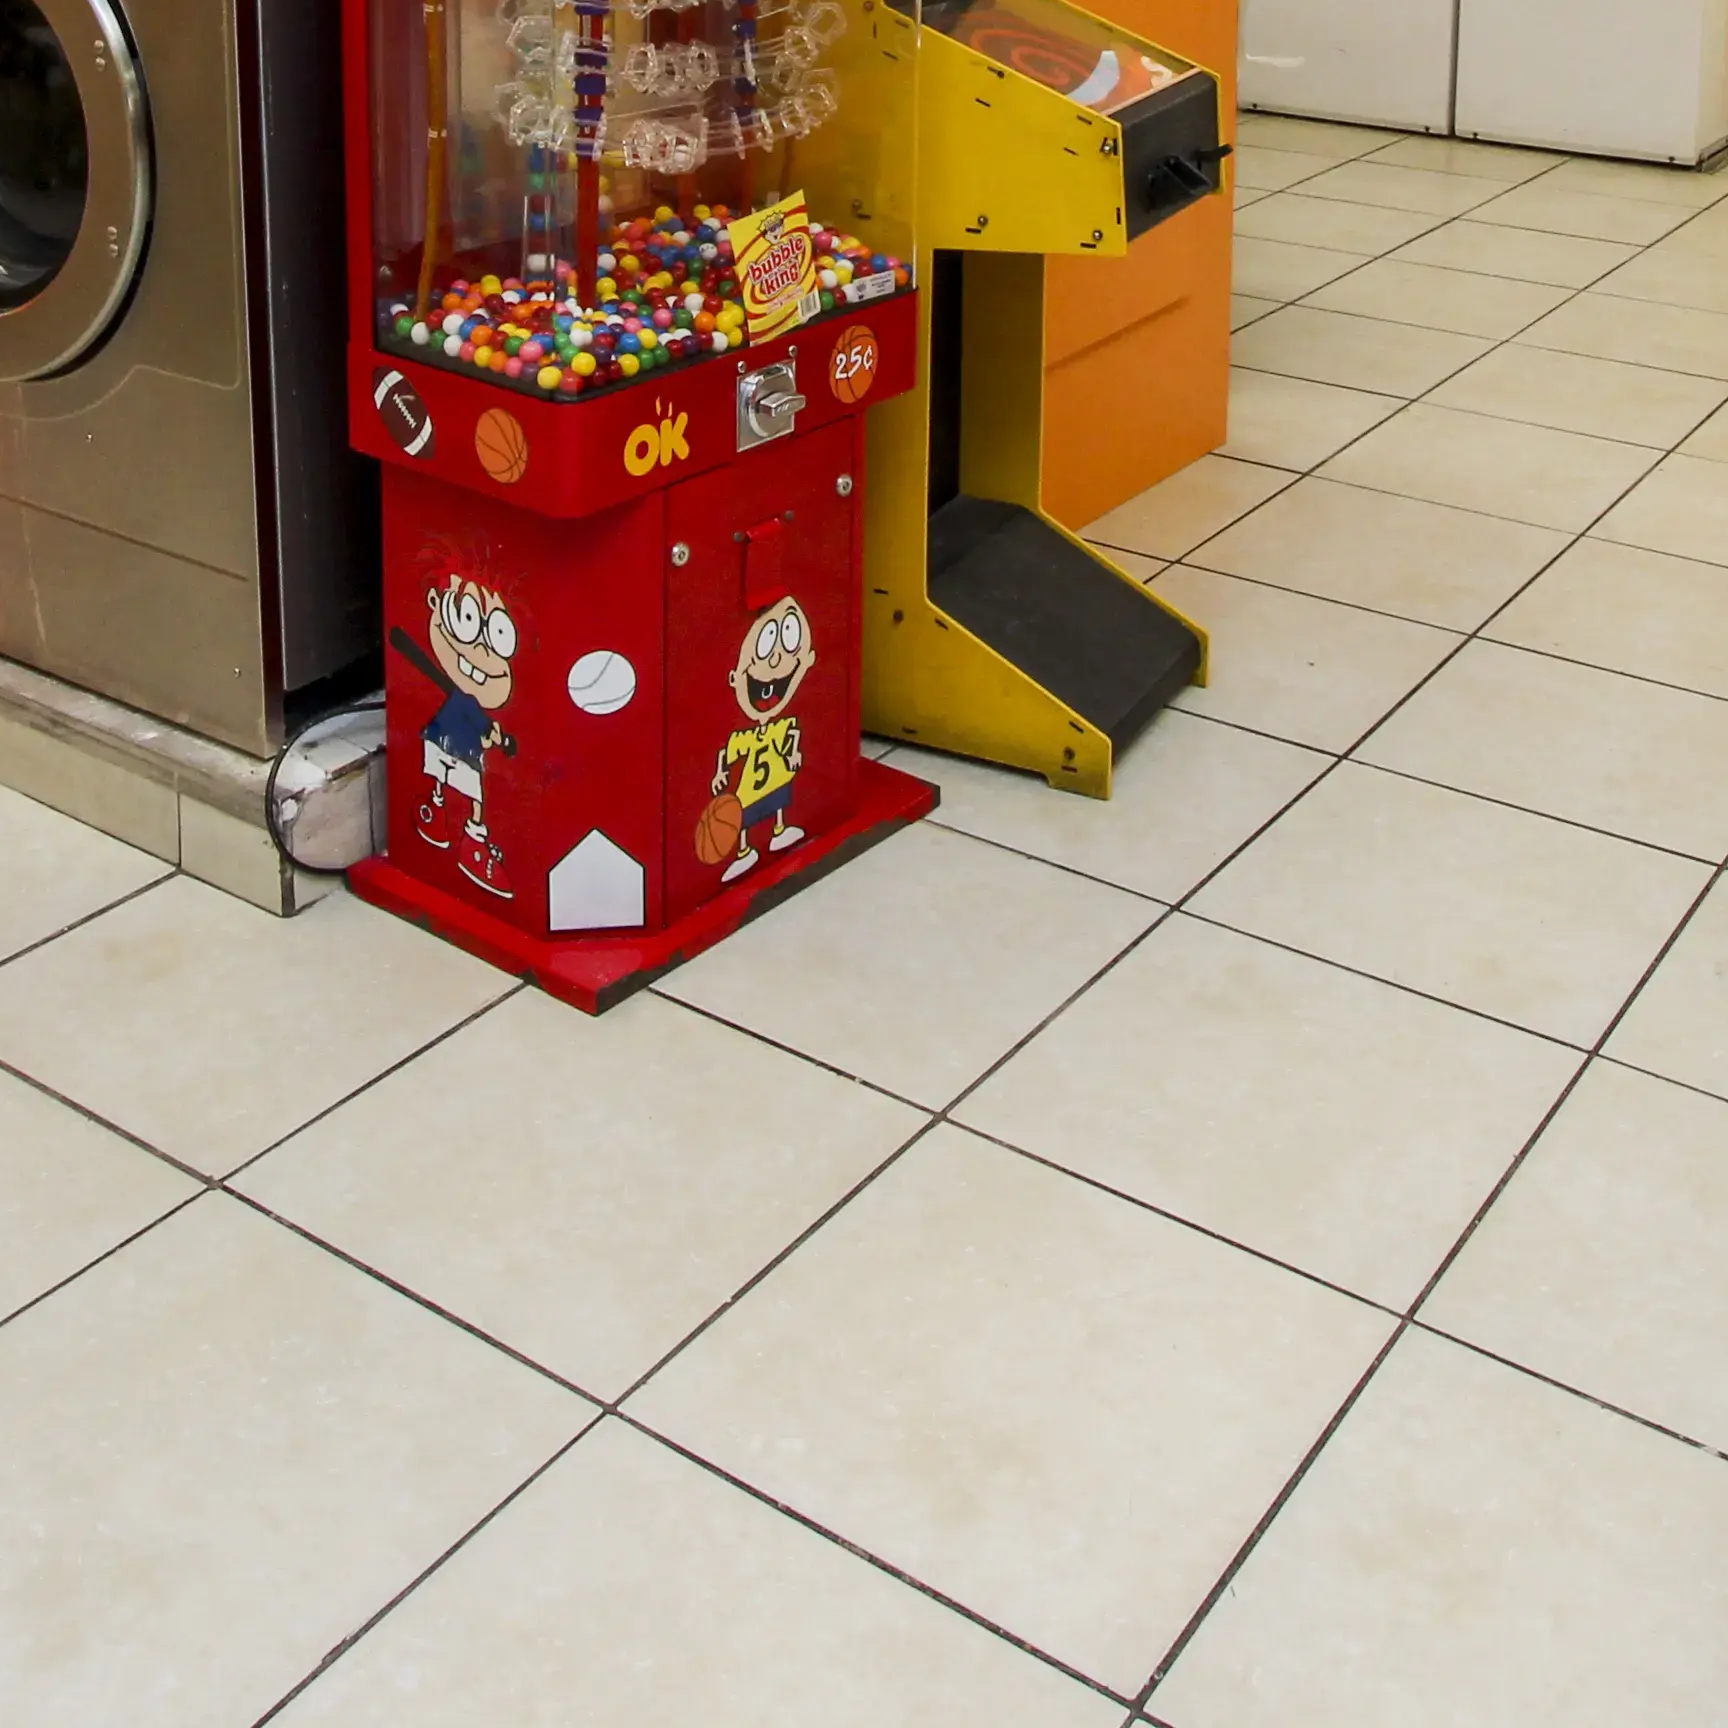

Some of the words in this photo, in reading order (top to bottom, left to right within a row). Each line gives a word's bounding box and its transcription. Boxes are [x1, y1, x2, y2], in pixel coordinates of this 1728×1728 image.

[749, 235, 805, 285] bubble
[763, 261, 801, 297] king
[835, 344, 874, 379] 25¢
[623, 410, 690, 477] OK
[753, 744, 770, 791] 5
